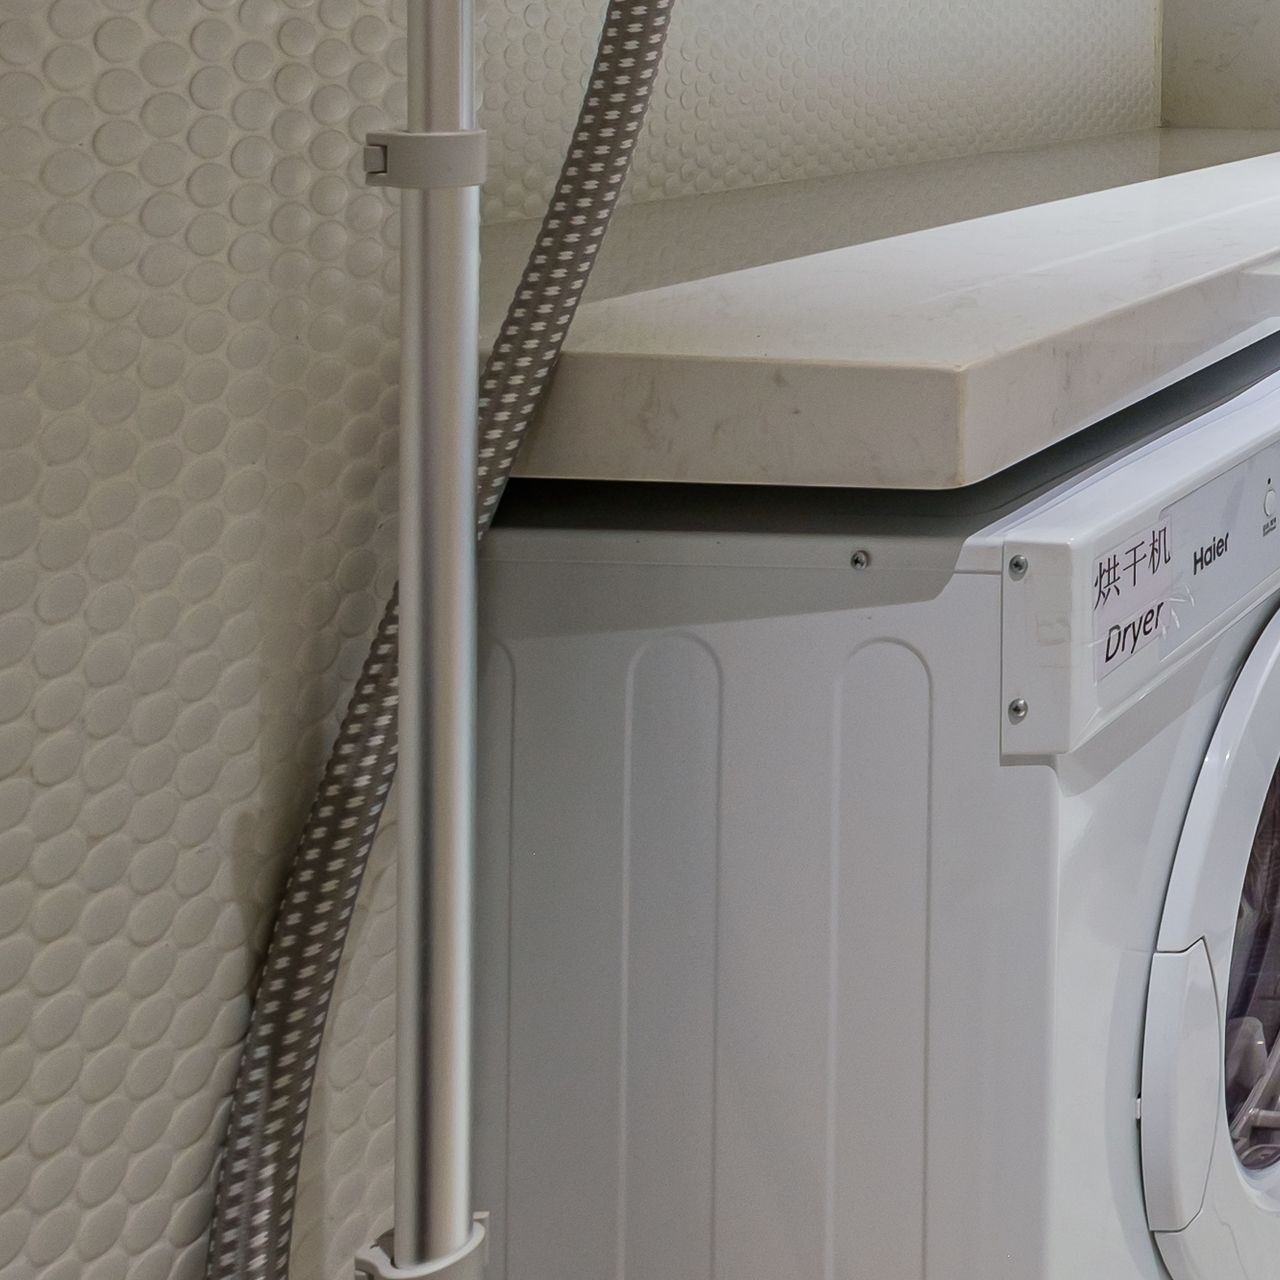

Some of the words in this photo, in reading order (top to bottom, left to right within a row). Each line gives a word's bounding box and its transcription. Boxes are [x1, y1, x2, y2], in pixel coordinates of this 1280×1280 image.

[1093, 526, 1171, 611] 烘干机
[1193, 532, 1229, 575] Haier
[1105, 601, 1164, 663] Dryer
